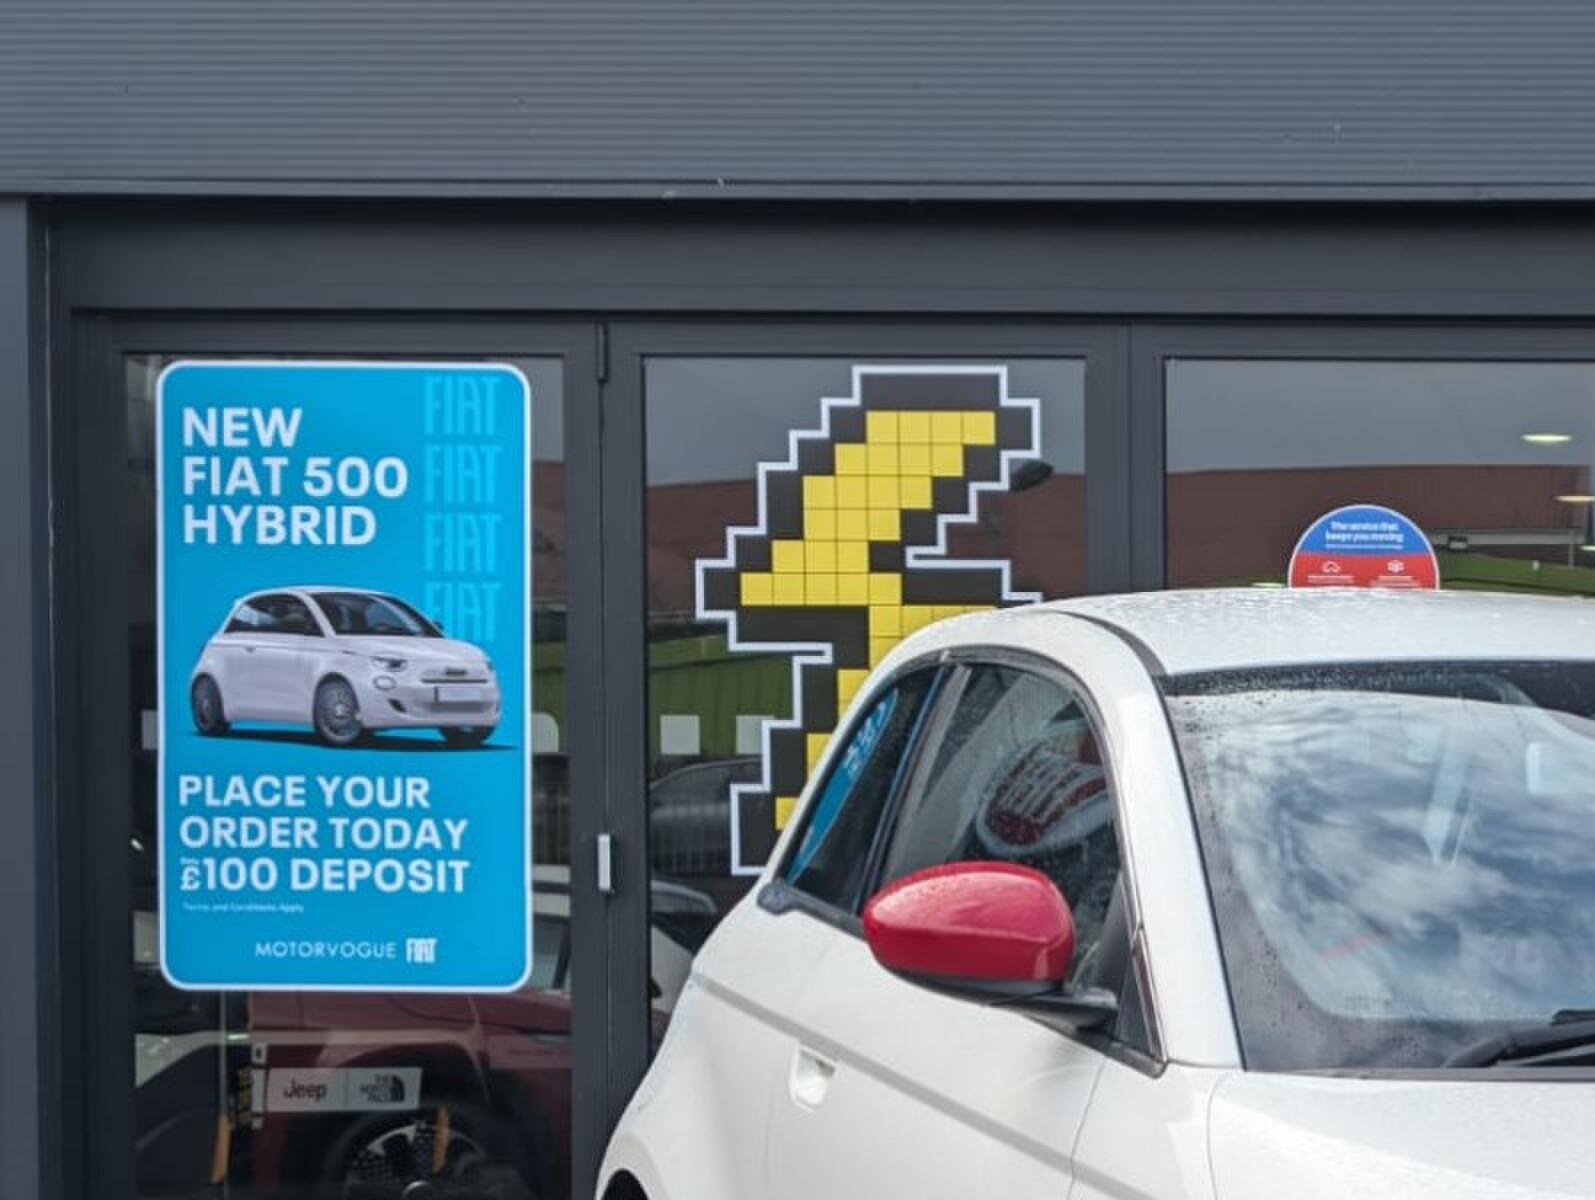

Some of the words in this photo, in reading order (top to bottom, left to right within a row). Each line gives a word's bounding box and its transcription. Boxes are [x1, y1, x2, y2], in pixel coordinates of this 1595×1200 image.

[424, 376, 501, 436] FIAT
[182, 407, 303, 448] NEW
[183, 456, 289, 496] FIAT
[302, 457, 409, 498] 500
[424, 444, 501, 503] FIAT
[183, 504, 377, 545] HYBRID
[424, 513, 501, 573] FIAT
[424, 582, 501, 642] FIAT
[178, 775, 306, 807] PLACE
[316, 776, 430, 808] YOUR
[179, 816, 318, 849] ORDER
[329, 818, 469, 850] TODAY
[179, 857, 278, 891] £100
[289, 859, 470, 893] DEPOSIT
[255, 940, 397, 959] MOTORVOGUE
[282, 1079, 328, 1101] Jeep
